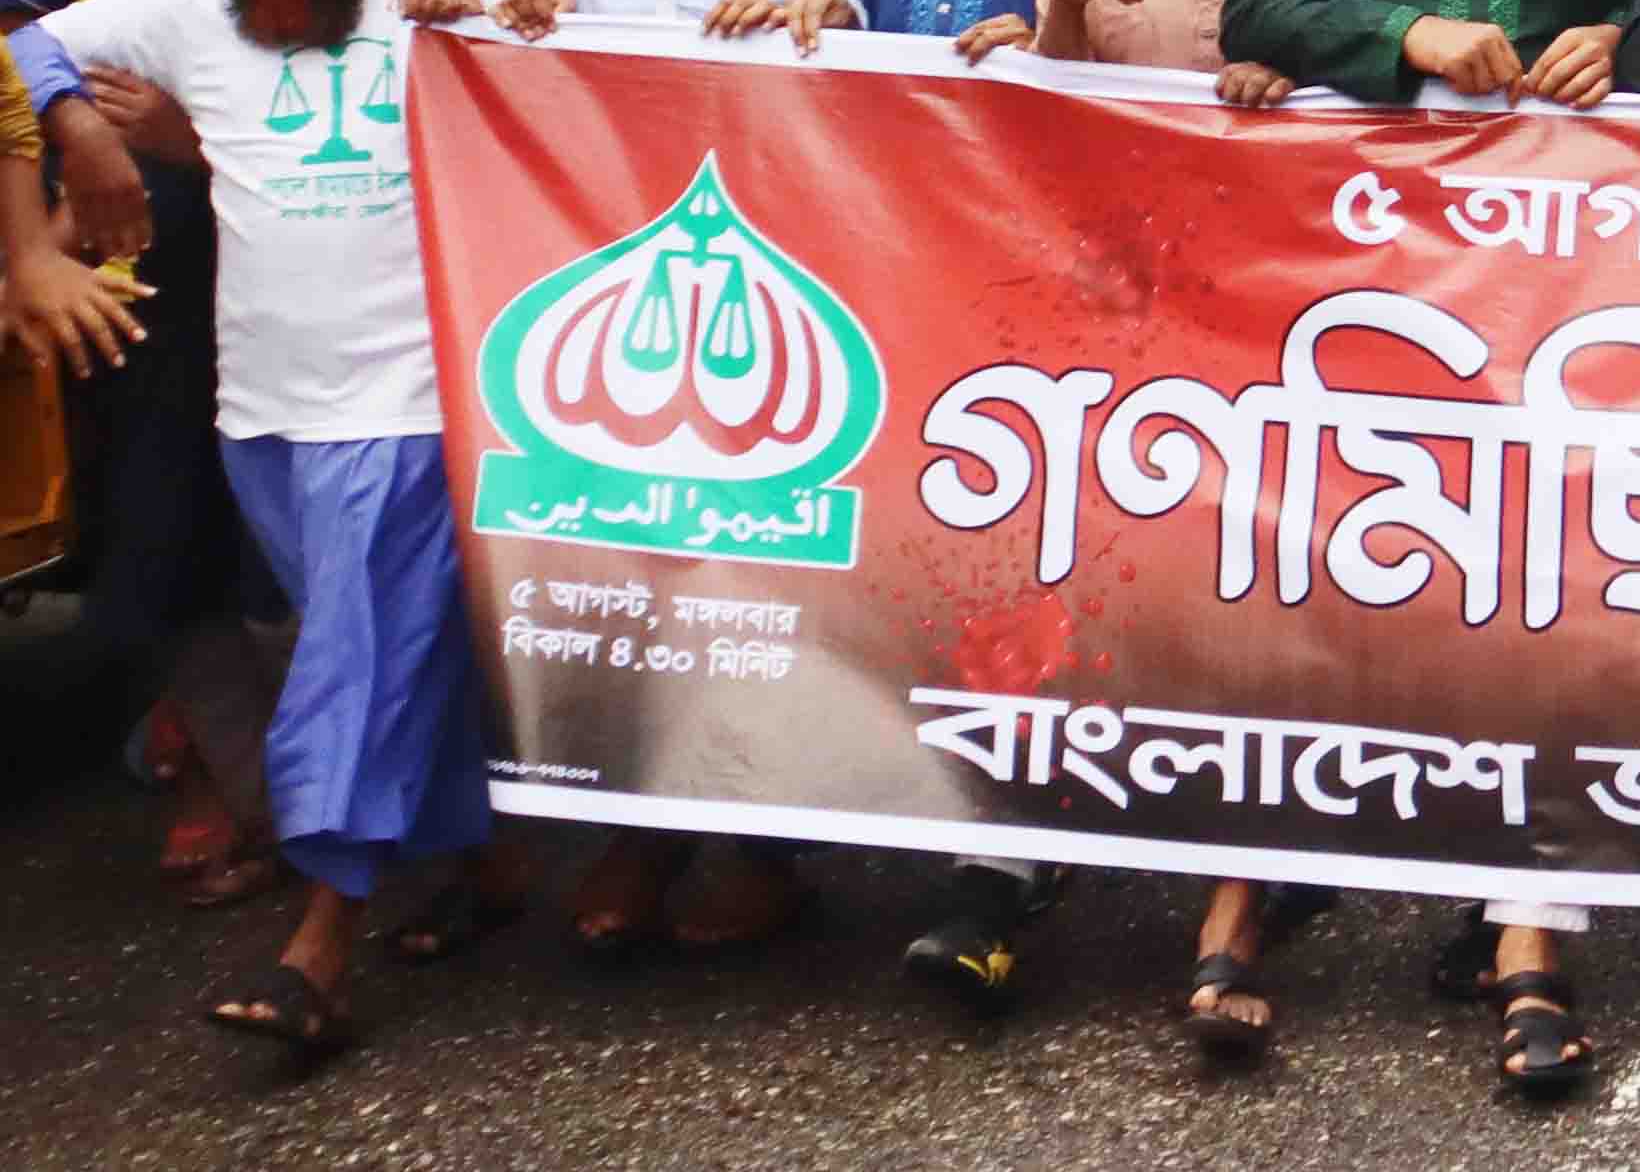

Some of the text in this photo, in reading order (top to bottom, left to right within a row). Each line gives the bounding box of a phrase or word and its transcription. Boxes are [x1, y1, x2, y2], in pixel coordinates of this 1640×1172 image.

[1331, 171, 1400, 244] ৫
[509, 578, 537, 610] ৫
[546, 578, 661, 631] আগস্ট,
[501, 615, 800, 681] বিকাল ৪.৩০ মিনিট
[909, 687, 1536, 826] বাংলাদেশ
